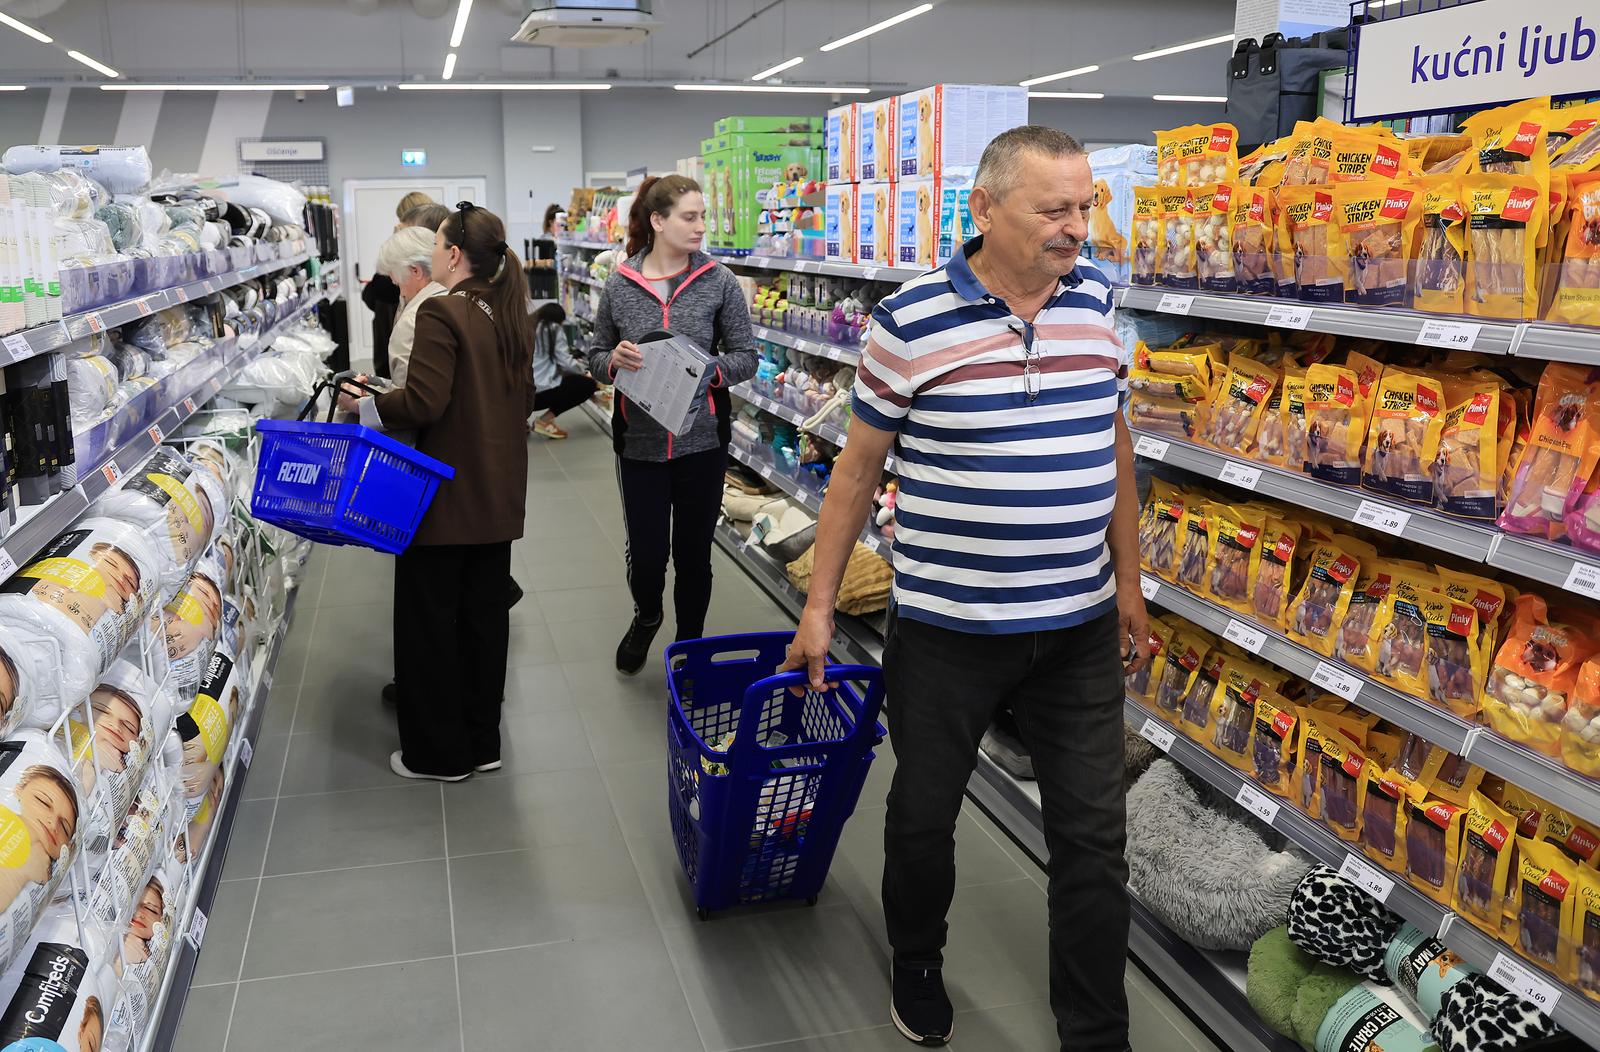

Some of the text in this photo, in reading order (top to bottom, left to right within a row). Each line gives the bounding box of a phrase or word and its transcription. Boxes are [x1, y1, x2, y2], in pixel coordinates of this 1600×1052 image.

[1411, 16, 1600, 84] kućni ljub
[1212, 135, 1231, 144] Pinky
[1313, 136, 1332, 150] CHICKE
[1182, 145, 1203, 157] BONES
[1337, 152, 1372, 164] CHICKEN
[1375, 154, 1398, 168] Pinky
[1337, 163, 1367, 174] STRIPS
[1286, 202, 1313, 215] CHICKEN
[1343, 199, 1382, 214] CHICKEN
[1384, 198, 1410, 209] Pinky
[1506, 198, 1534, 210] Pinky
[1347, 210, 1375, 224] STRIPS
[1309, 384, 1334, 393] CHICKEN
[1384, 390, 1414, 401] CHICKEN
[1417, 394, 1437, 408] Pinky
[1467, 404, 1488, 414] Pinky
[277, 461, 321, 485] ACTION
[1239, 529, 1256, 541] Pinky
[1333, 561, 1352, 576] Pinky
[1471, 599, 1497, 613] Pinky
[1450, 613, 1470, 625] Pinky
[1275, 716, 1289, 732] Pinky
[1308, 728, 1320, 738] Fill
[1322, 742, 1341, 757] Fillets
[1348, 756, 1361, 770] Pinky
[1430, 805, 1452, 820] Pinky
[1487, 826, 1505, 844] Pinky
[1571, 833, 1597, 851] Pinky
[1382, 847, 1393, 856] LARGE
[1428, 876, 1443, 886] LARGE
[1543, 876, 1566, 893] Pinky
[1412, 948, 1435, 974] MAT
[25, 955, 70, 1024] Comfibeds
[1374, 1008, 1399, 1027] PET
[1349, 1021, 1379, 1052] CRATE
